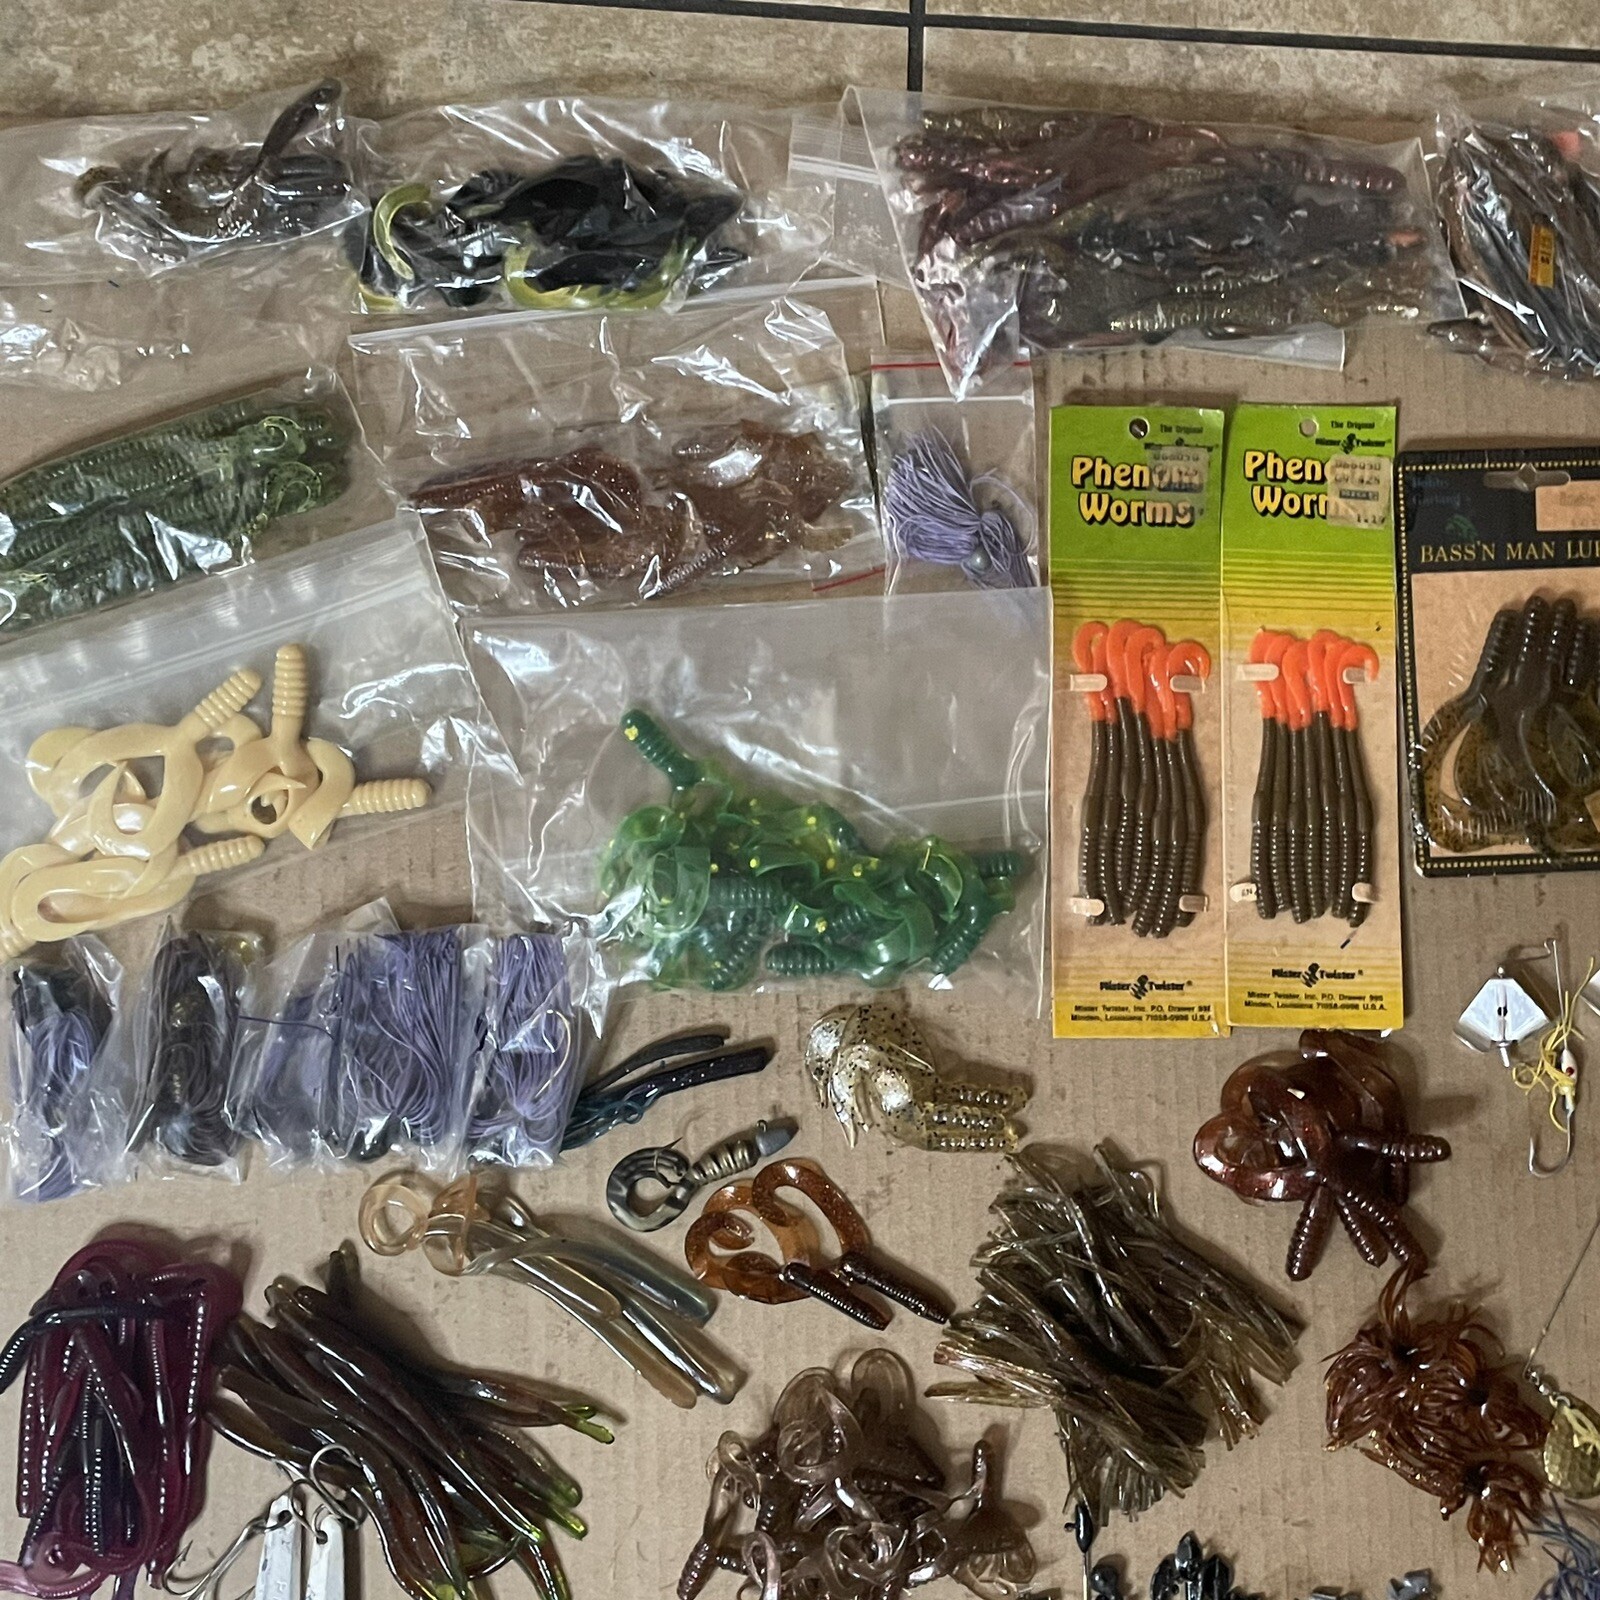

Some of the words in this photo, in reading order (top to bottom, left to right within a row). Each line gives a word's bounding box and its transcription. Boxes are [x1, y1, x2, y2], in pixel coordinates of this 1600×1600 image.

[1079, 491, 1195, 528] Worms
[1420, 541, 1496, 563] BASS'N
[1506, 541, 1556, 561] MAN
